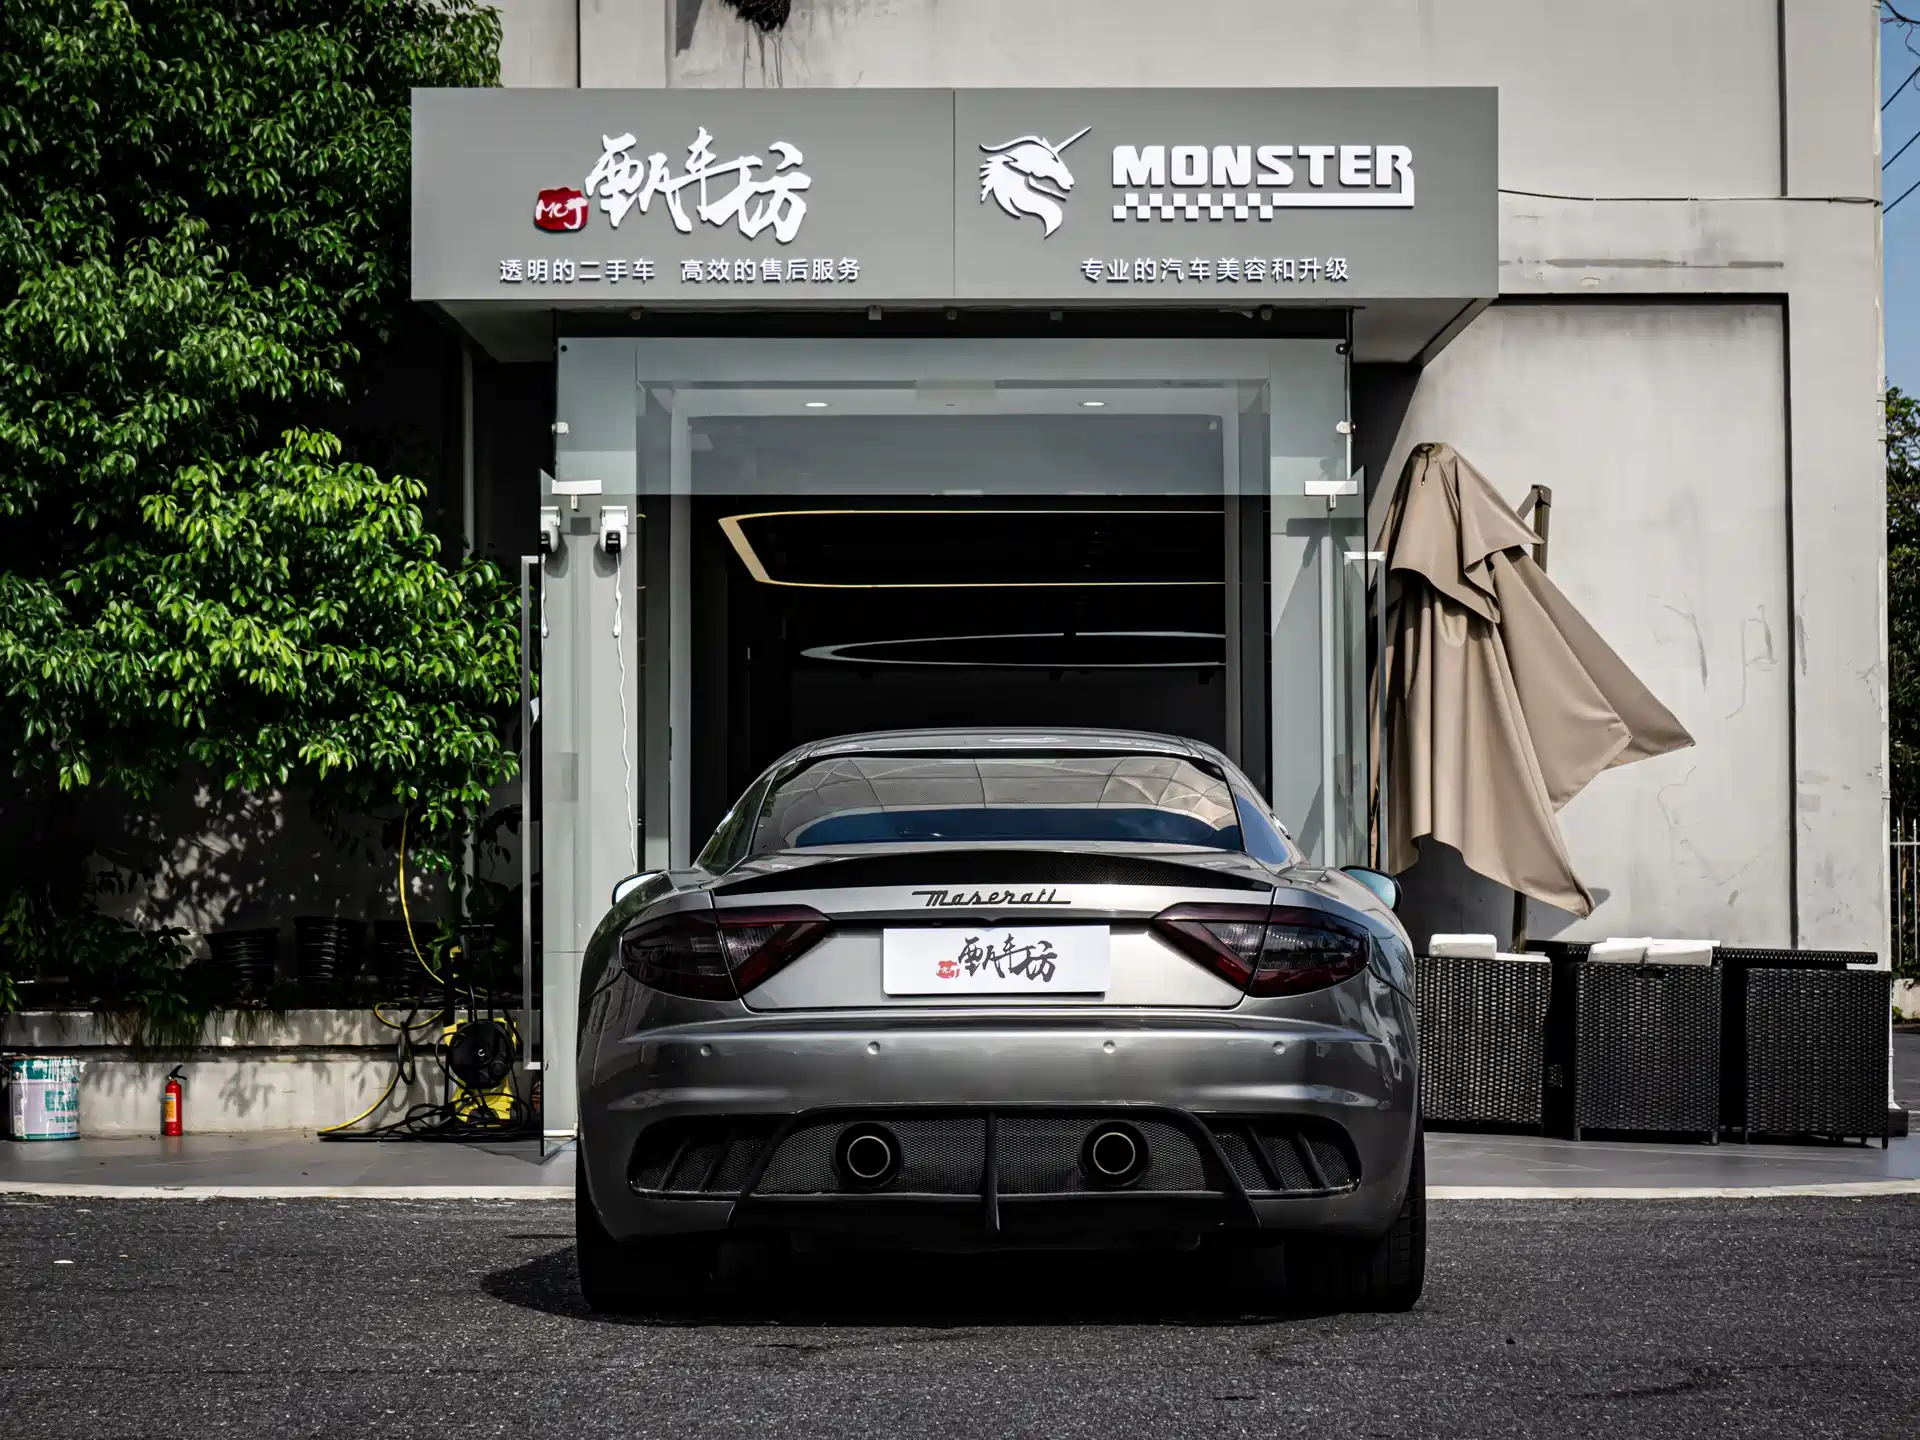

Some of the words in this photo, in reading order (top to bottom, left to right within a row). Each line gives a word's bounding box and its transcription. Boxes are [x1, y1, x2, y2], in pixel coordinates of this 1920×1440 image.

[1112, 145, 1415, 192] MONSTER
[535, 196, 588, 230] MCJ
[499, 257, 656, 282] 透明的二手车
[680, 256, 861, 282] 高效的售后服务
[1081, 256, 1349, 282] 专业的汽车美容和升级
[911, 888, 1072, 907] Maserati
